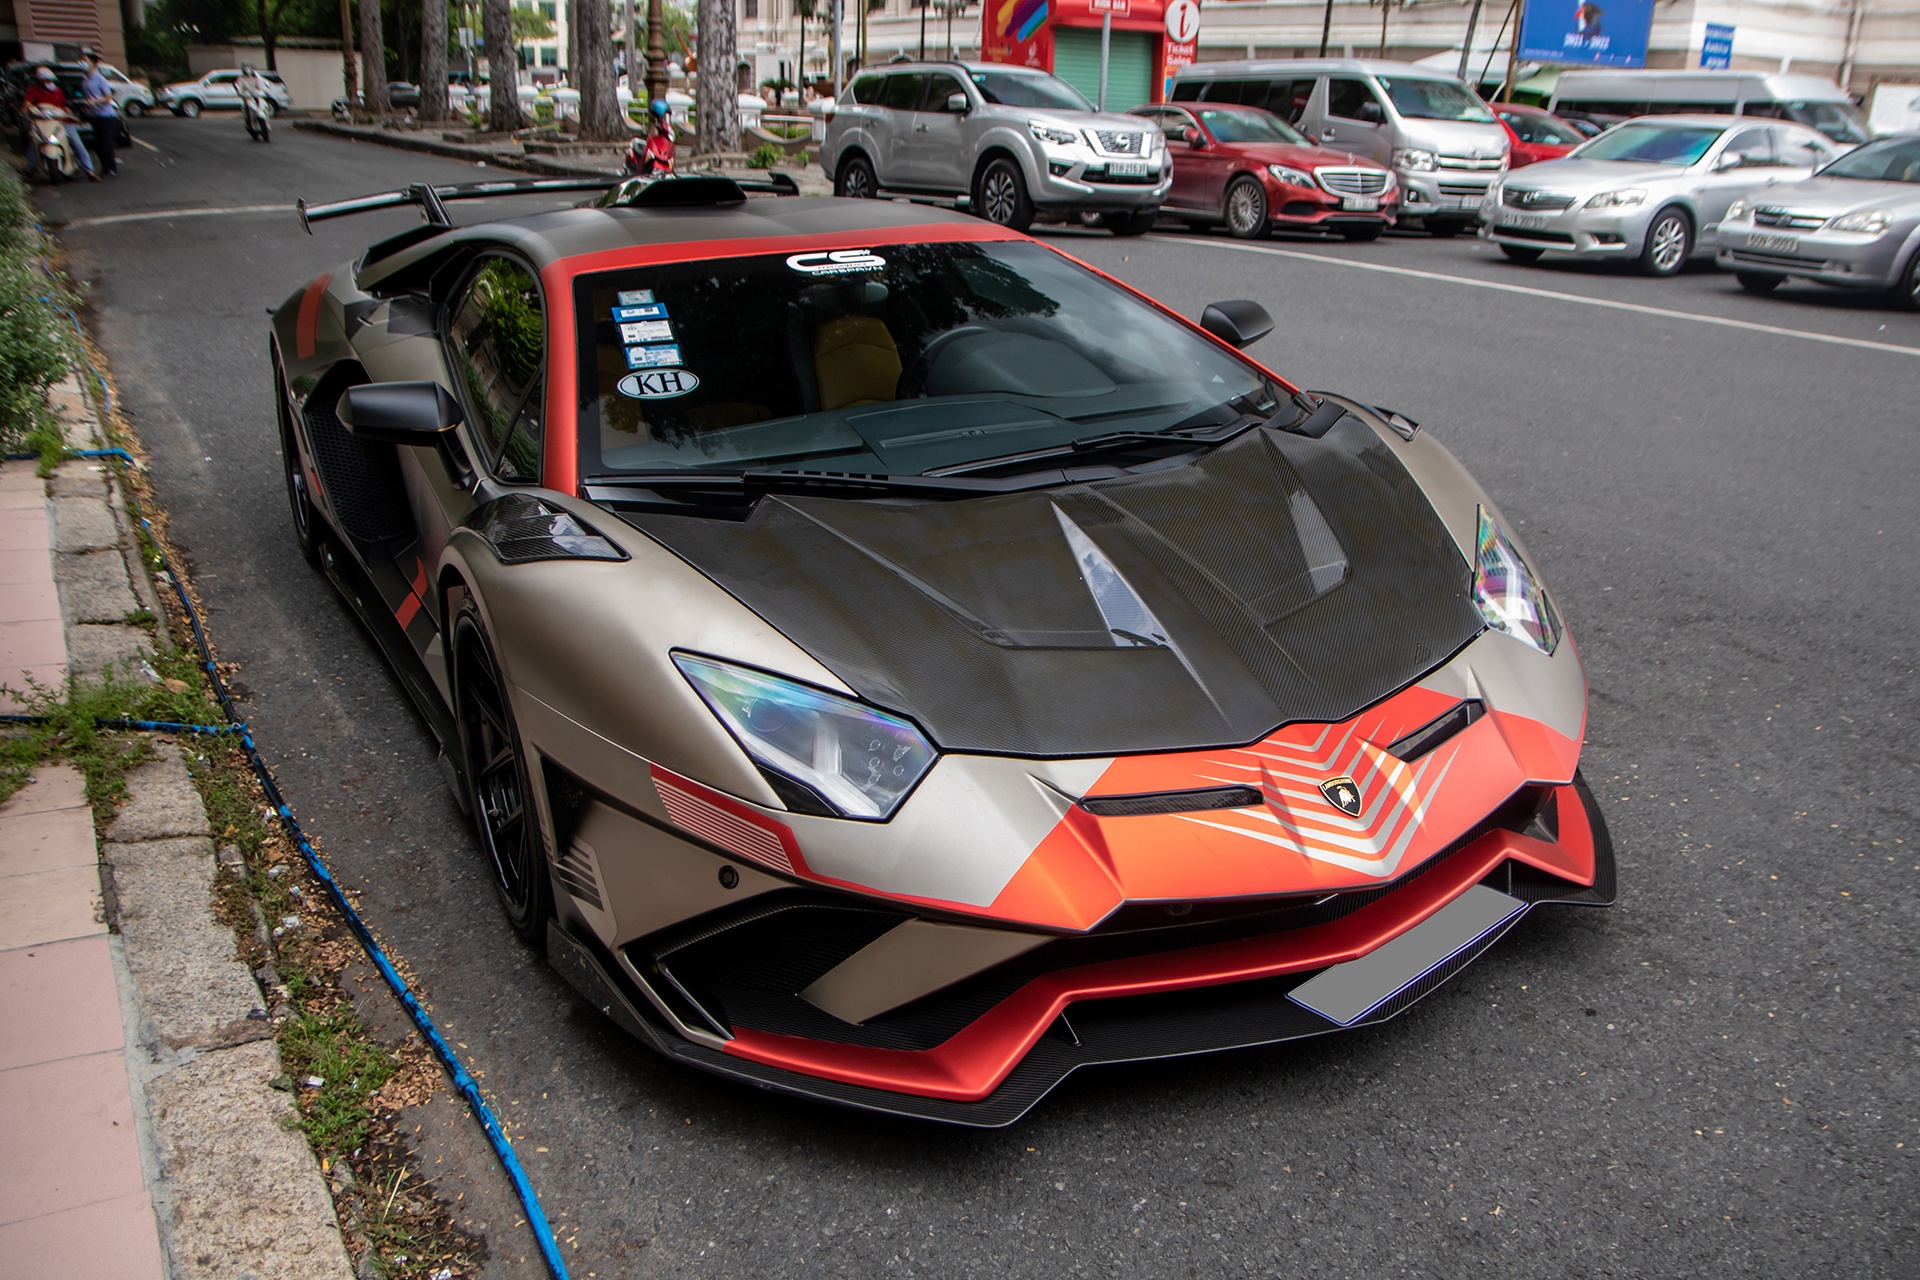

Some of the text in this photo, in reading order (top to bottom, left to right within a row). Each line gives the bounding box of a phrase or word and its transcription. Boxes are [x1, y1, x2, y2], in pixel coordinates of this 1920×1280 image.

[1167, 42, 1193, 55] Ticket
[1166, 54, 1192, 67] Sales
[633, 371, 686, 396] KH
